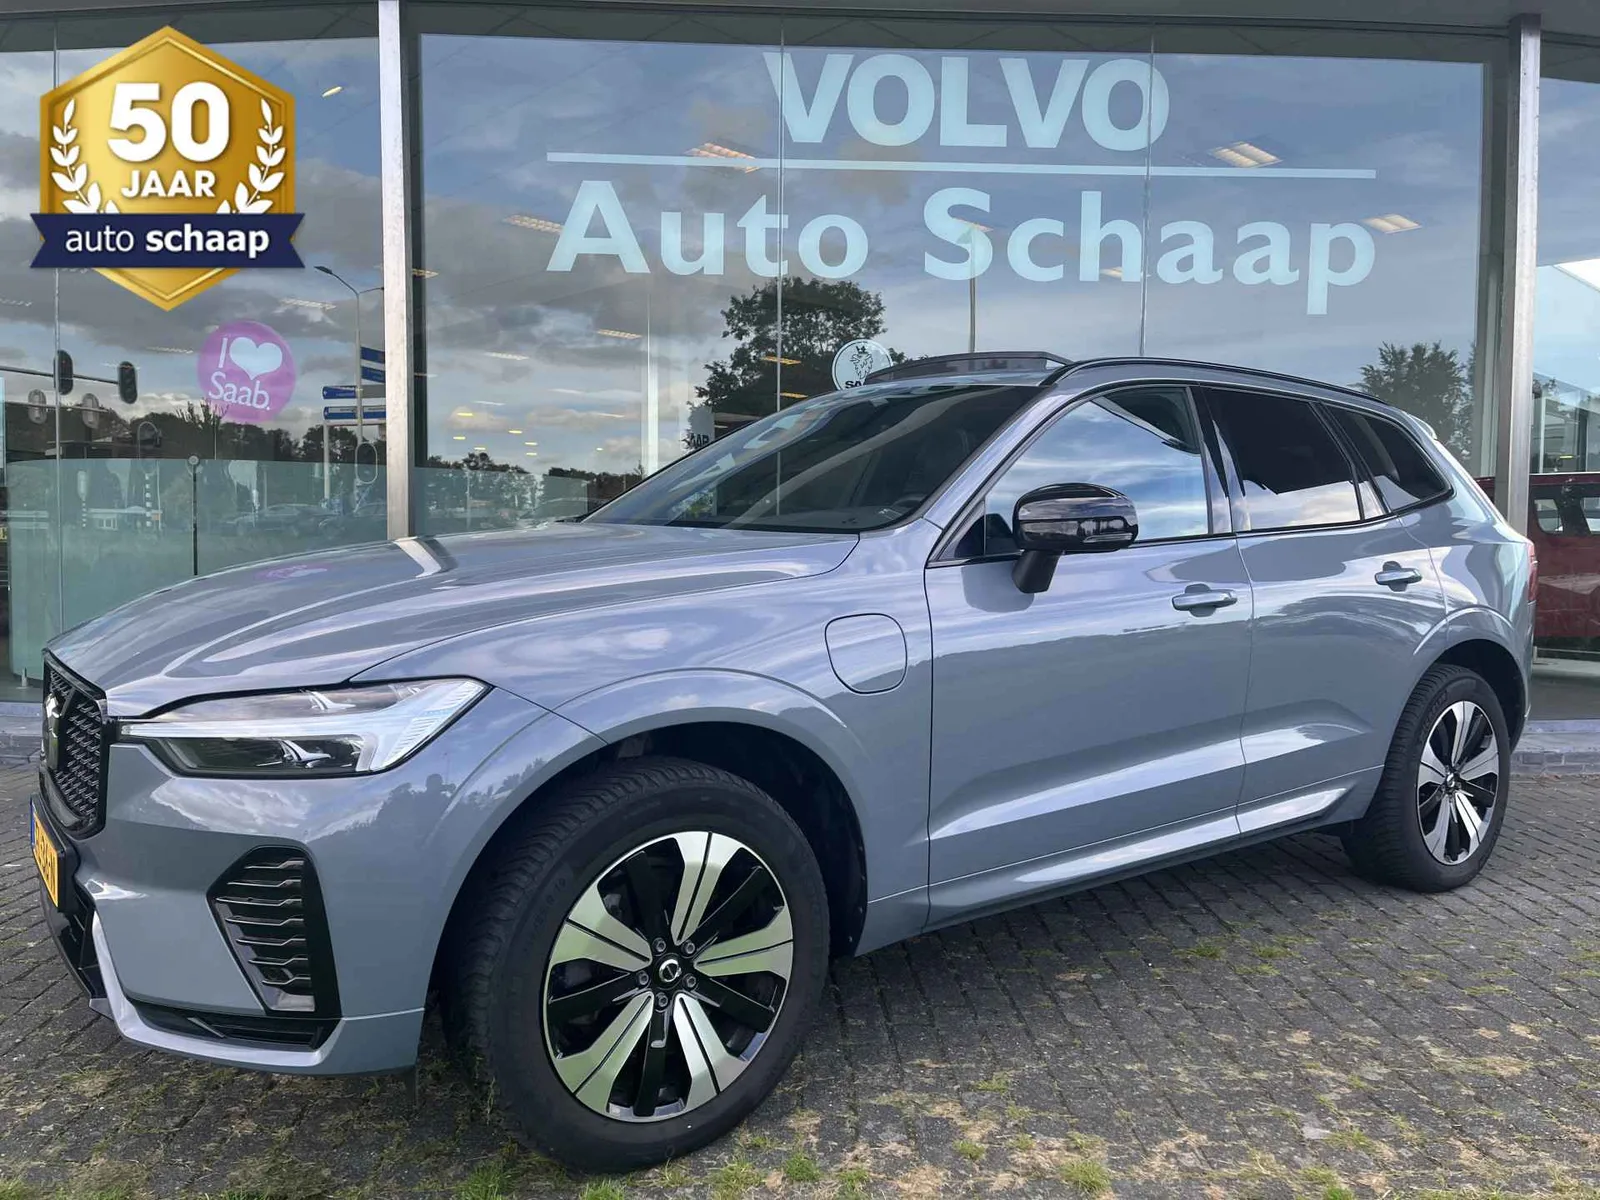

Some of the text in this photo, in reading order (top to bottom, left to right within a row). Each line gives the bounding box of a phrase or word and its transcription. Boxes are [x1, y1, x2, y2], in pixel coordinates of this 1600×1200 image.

[763, 52, 1170, 151] VOLVO
[547, 180, 1376, 315] Auto Schaap
[218, 337, 229, 369] I
